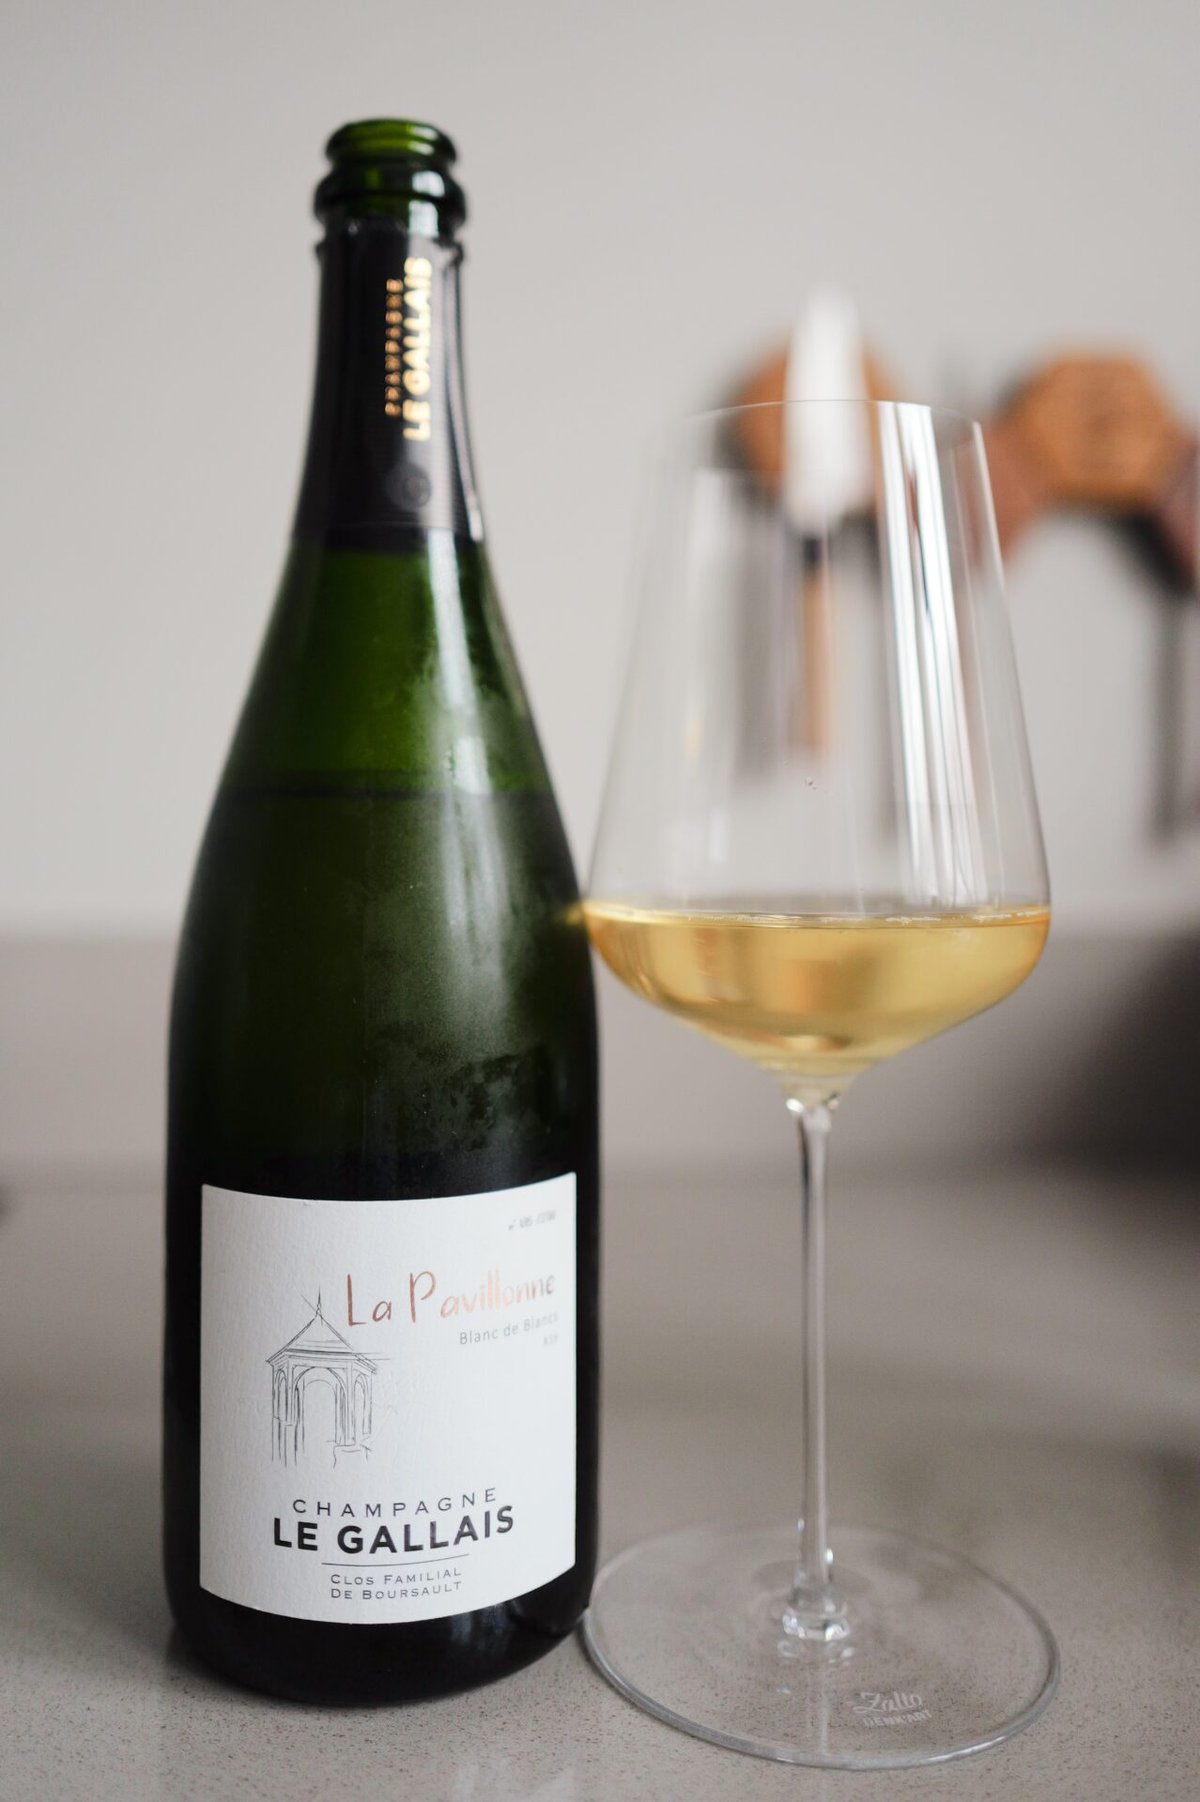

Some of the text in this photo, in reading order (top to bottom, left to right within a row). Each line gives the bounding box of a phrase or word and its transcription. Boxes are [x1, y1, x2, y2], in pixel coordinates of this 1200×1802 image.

[402, 257, 433, 441] LE GALLAIS
[346, 1270, 556, 1327] La Pavillonne
[459, 1329, 499, 1345] Blanc
[503, 1323, 519, 1337] de
[292, 1487, 496, 1518] CHAMPAGNE
[273, 1505, 514, 1555] LE GALLAIS
